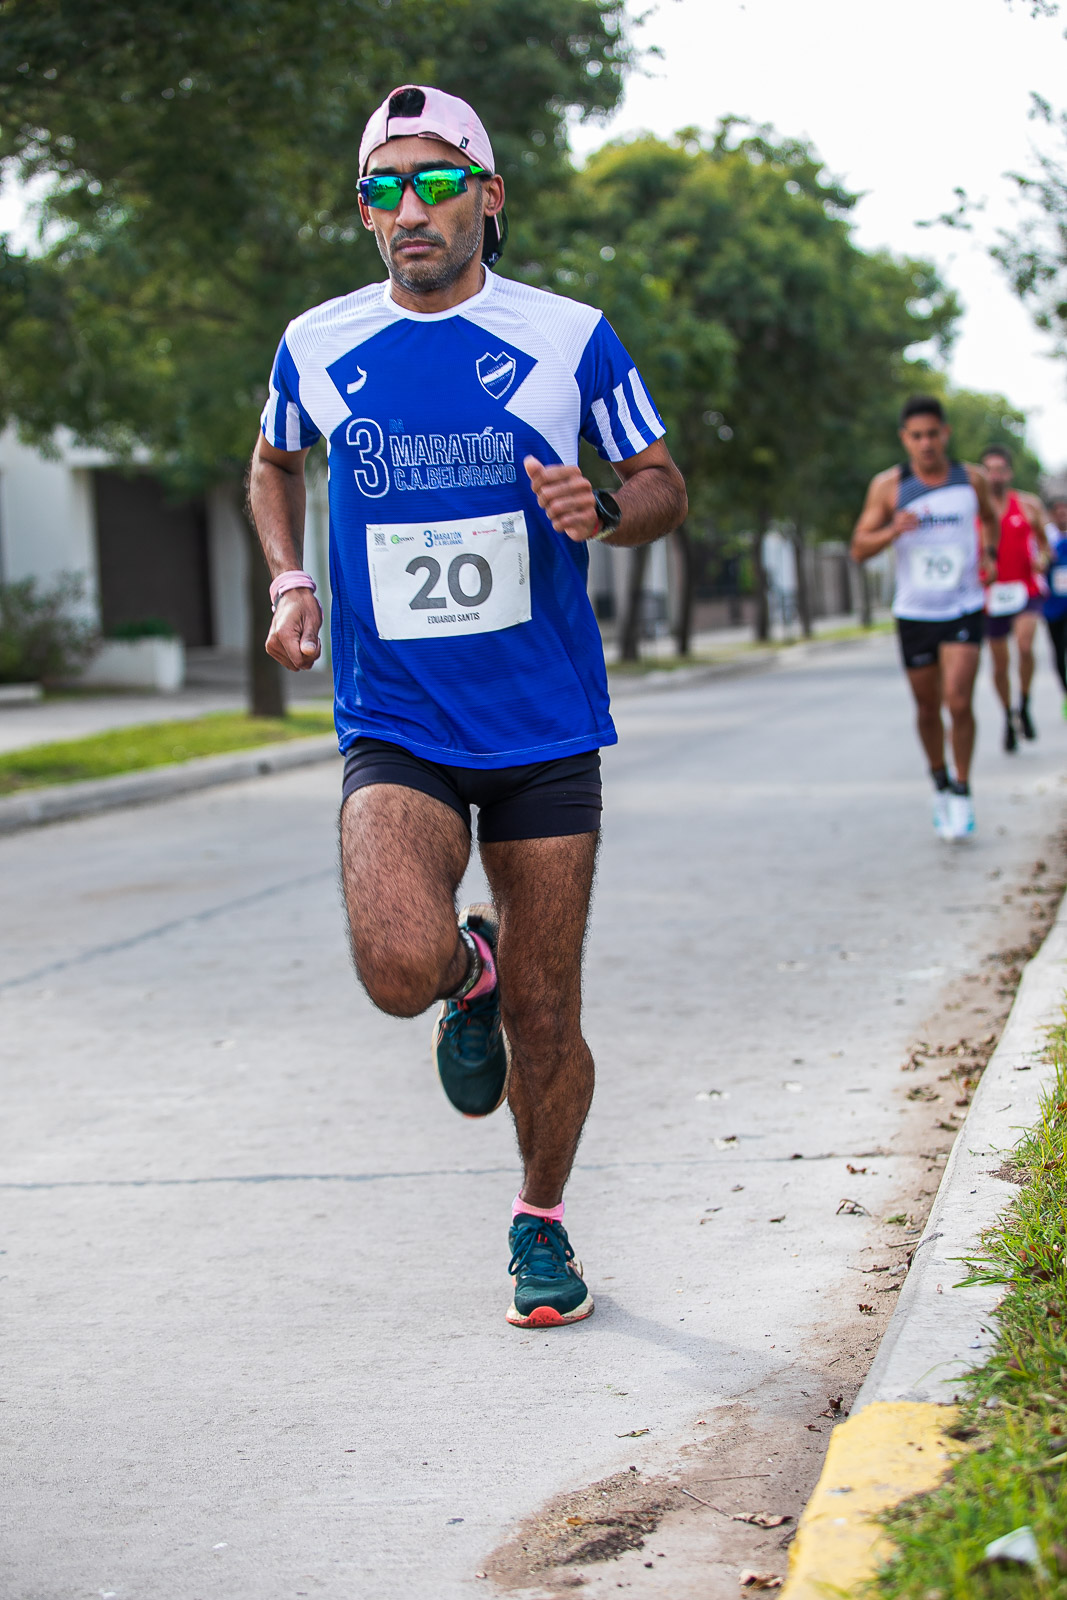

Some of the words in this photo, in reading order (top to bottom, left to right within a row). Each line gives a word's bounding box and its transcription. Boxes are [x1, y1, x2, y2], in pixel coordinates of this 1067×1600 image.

[346, 417, 390, 498] 3
[389, 426, 514, 467] MARATÓN
[423, 529, 434, 548] 3
[405, 553, 493, 610] 20
[427, 614, 457, 624] EDUARDO
[457, 611, 481, 622] SANTIS
